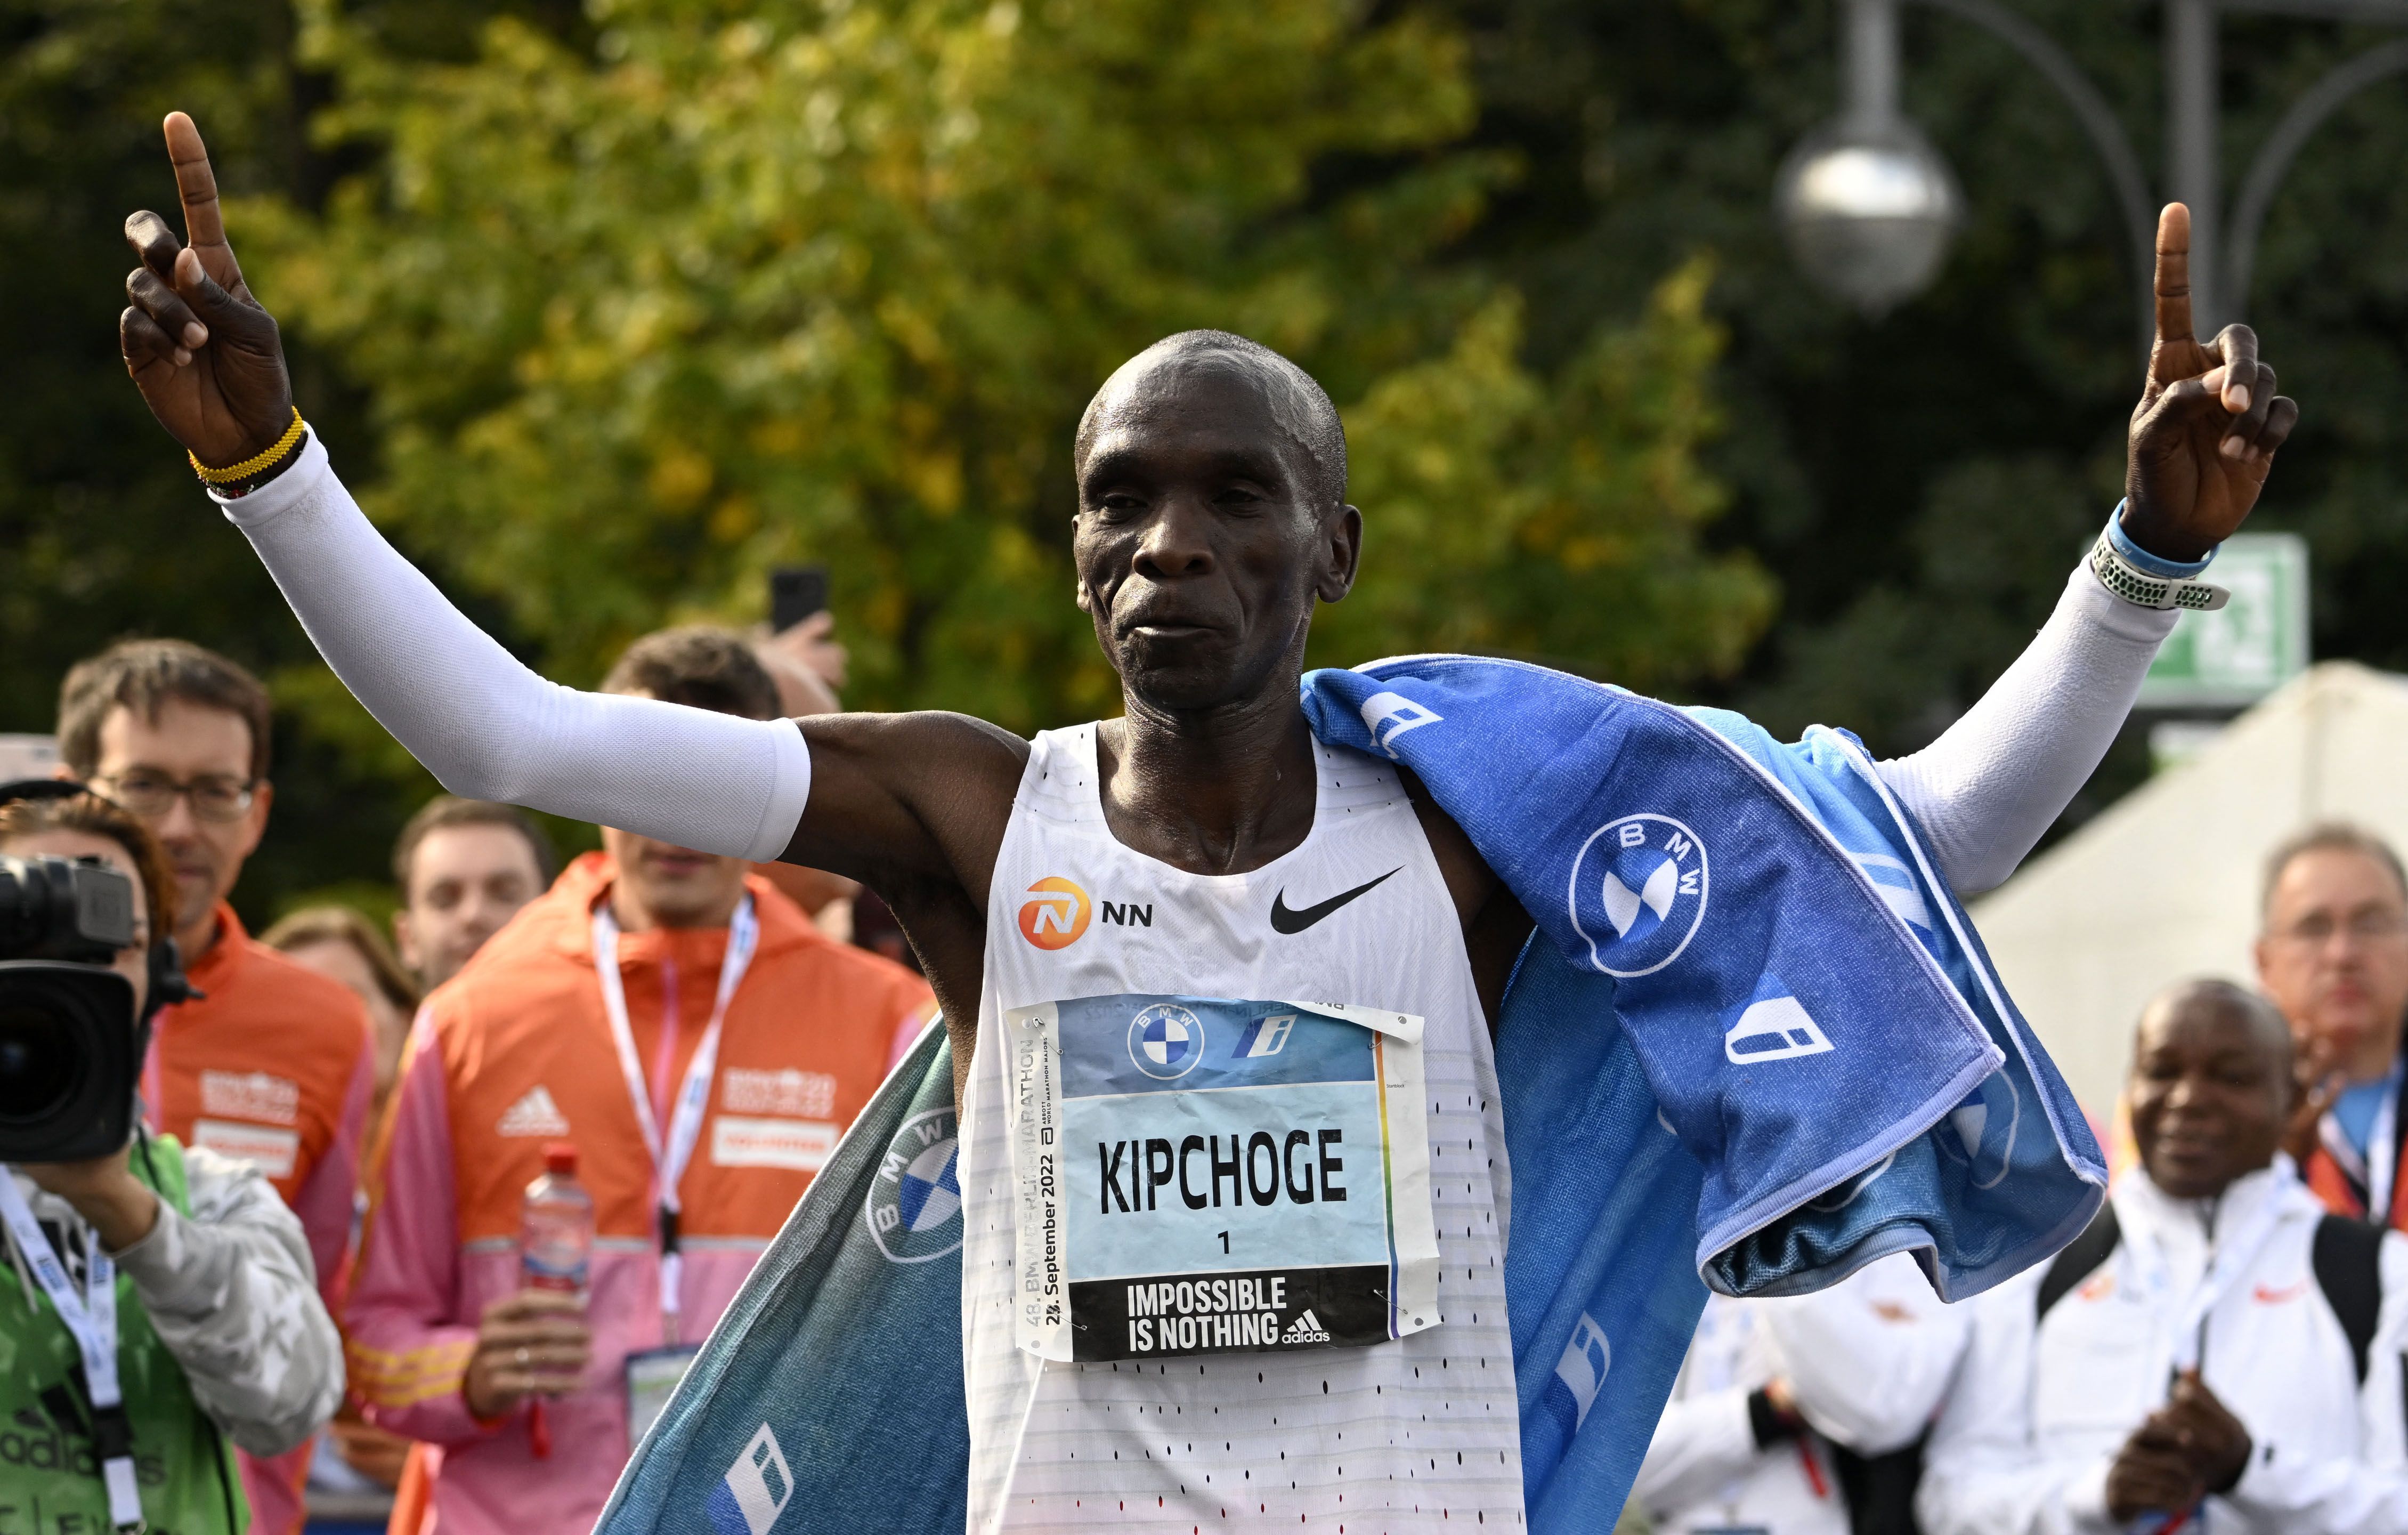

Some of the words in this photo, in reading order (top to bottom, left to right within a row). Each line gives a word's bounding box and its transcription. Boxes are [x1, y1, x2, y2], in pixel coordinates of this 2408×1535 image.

[1619, 823, 1700, 895] BMW
[1102, 901, 1152, 927] NN
[1137, 1007, 1194, 1029] BMW
[1020, 1039, 1038, 1238] BERLIN-MARATHON
[875, 1119, 942, 1233] BMW
[1040, 1154, 1055, 1198] 2022
[1099, 1129, 1347, 1214] KIPCHOGE
[1042, 1201, 1060, 1295] September
[1218, 1231, 1229, 1254] 1
[1025, 1242, 1040, 1292] BMW
[1128, 1277, 1287, 1317] IMPOSSIBLE
[1129, 1319, 1153, 1352] IS
[1160, 1312, 1278, 1350] NOTHING
[1282, 1330, 1330, 1344] adidas
